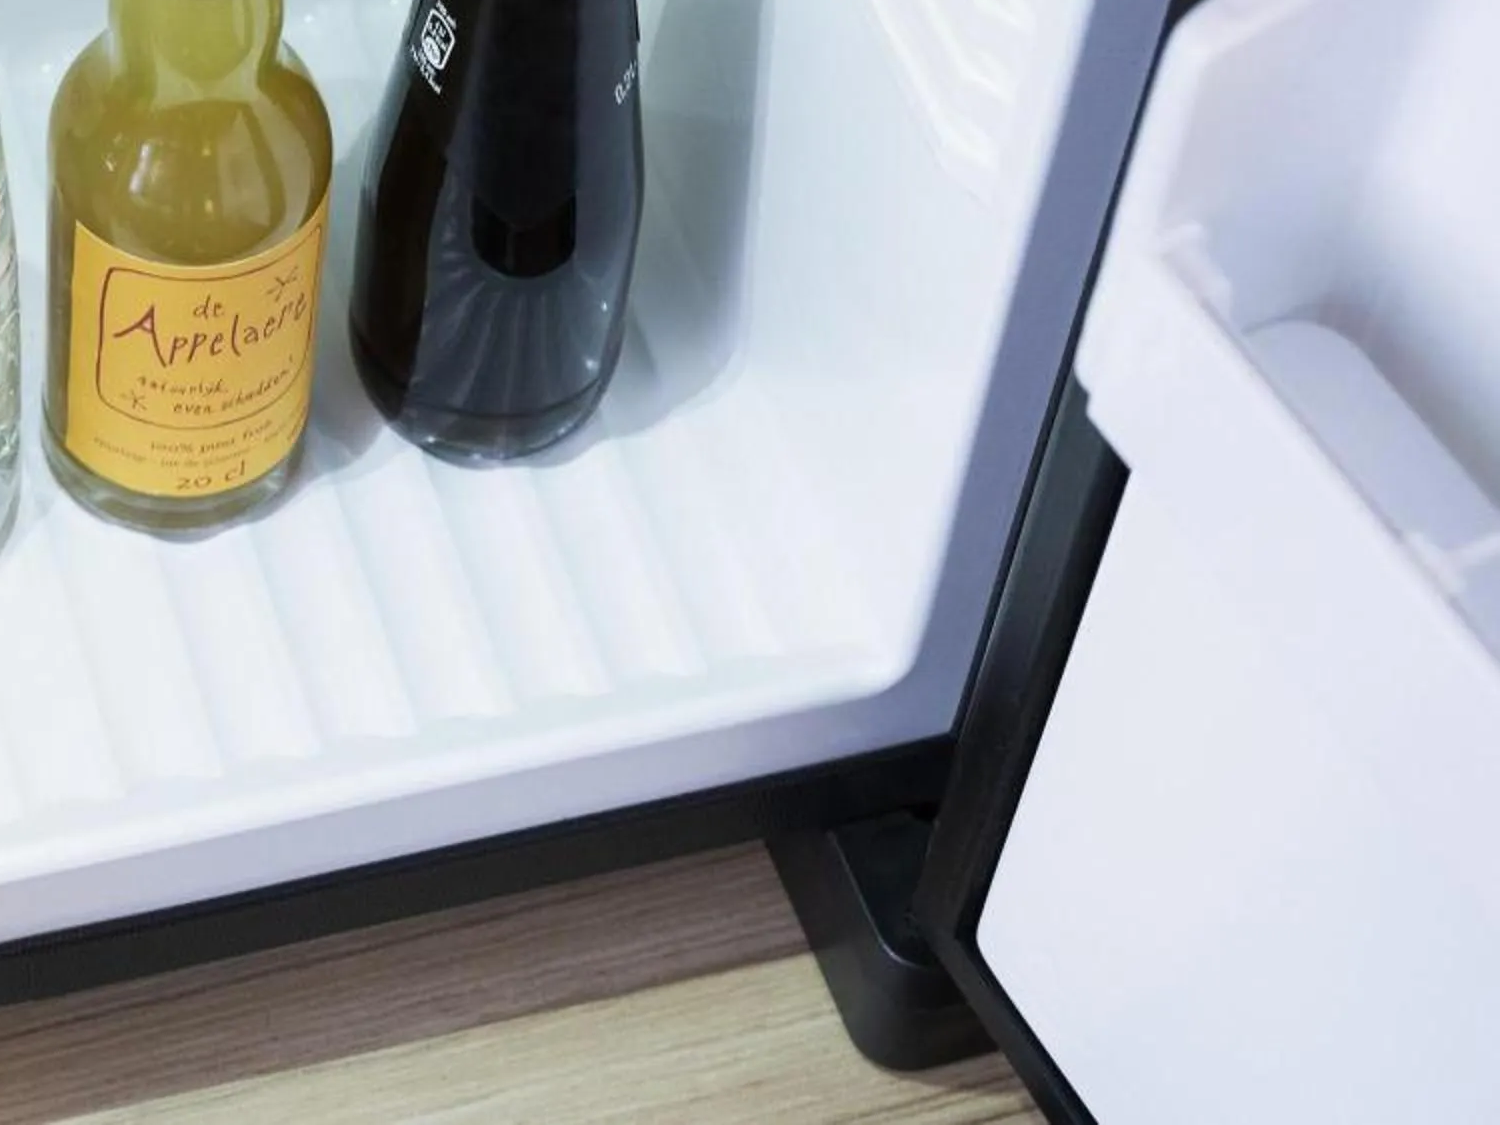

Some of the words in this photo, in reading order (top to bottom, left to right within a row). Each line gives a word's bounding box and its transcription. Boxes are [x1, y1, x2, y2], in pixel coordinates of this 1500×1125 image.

[192, 294, 225, 319] de
[176, 475, 213, 491] 20
[224, 459, 247, 484] cl
